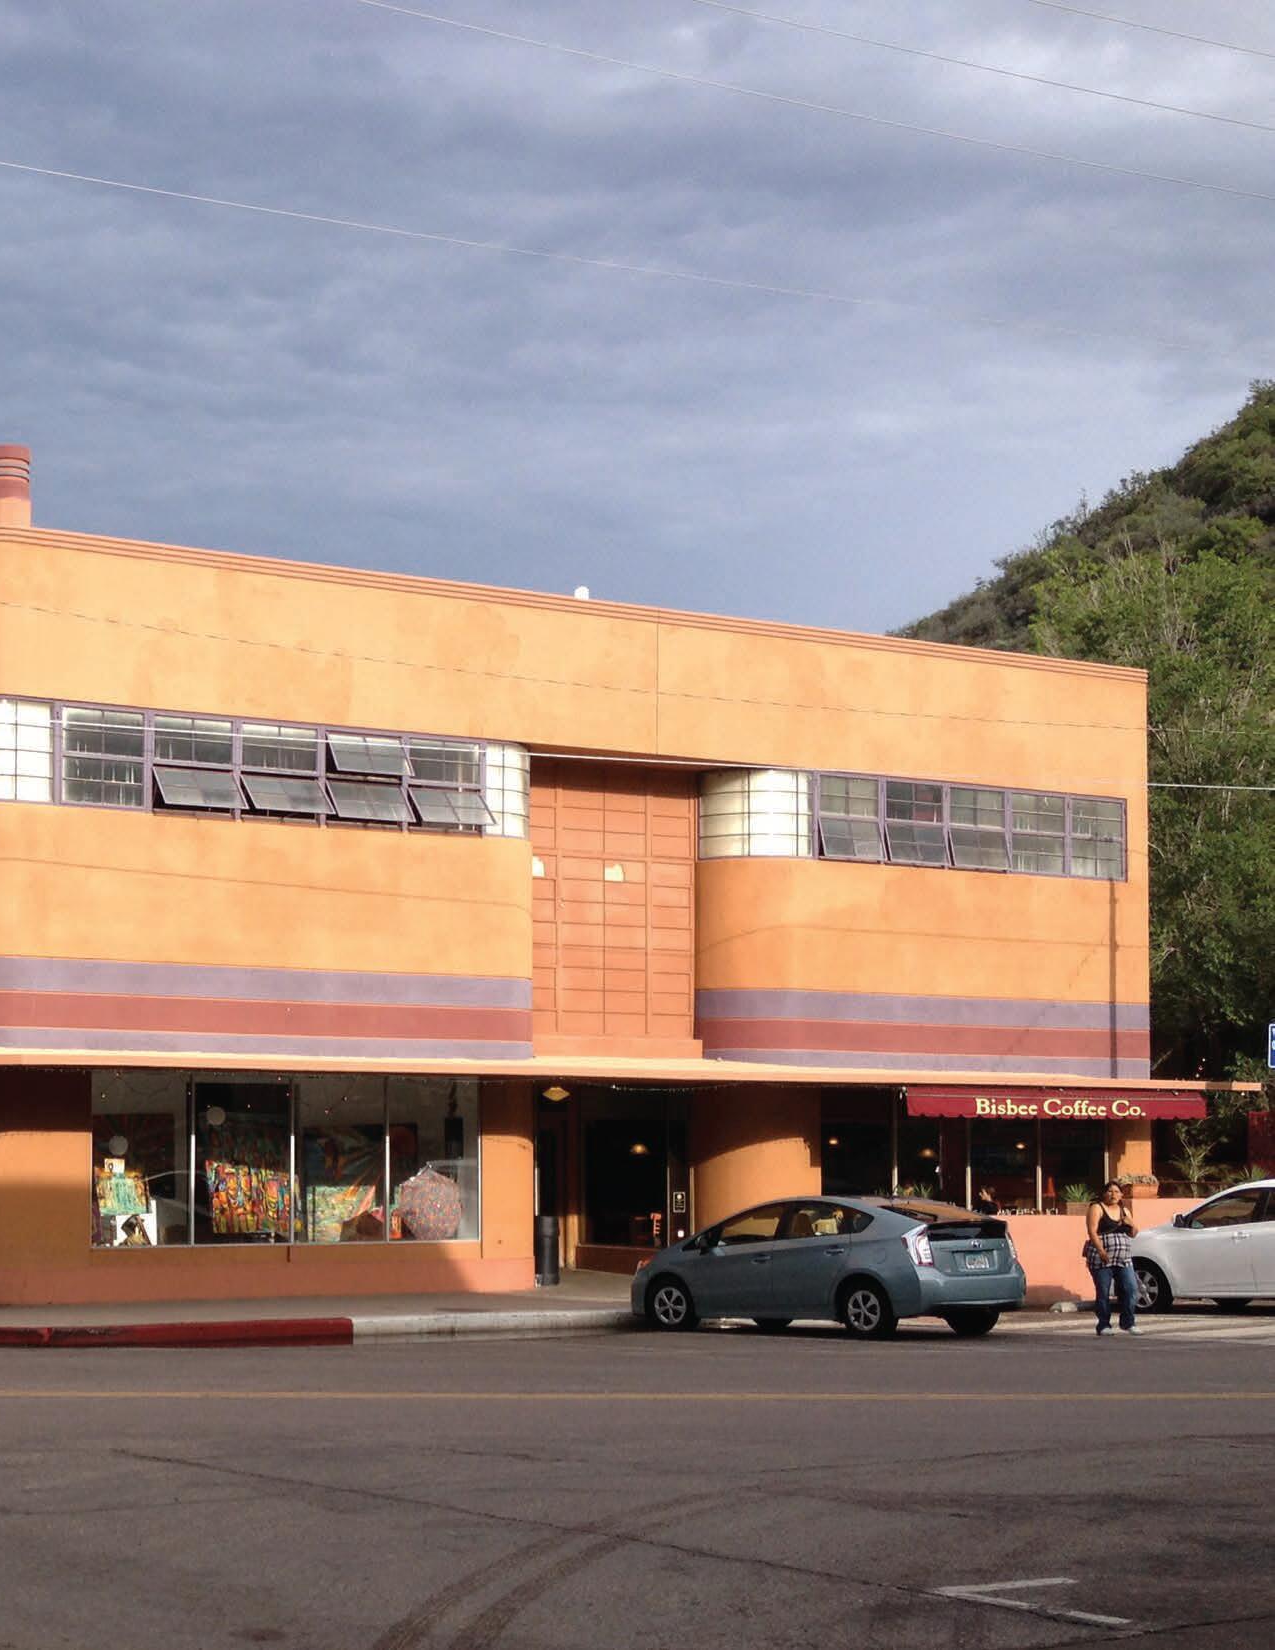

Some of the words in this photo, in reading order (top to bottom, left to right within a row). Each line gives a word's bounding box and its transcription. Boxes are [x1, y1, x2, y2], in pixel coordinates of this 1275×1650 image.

[975, 1098, 1038, 1115] Bisbee
[1043, 1098, 1107, 1117] Coffee
[1111, 1099, 1147, 1117] Co.
